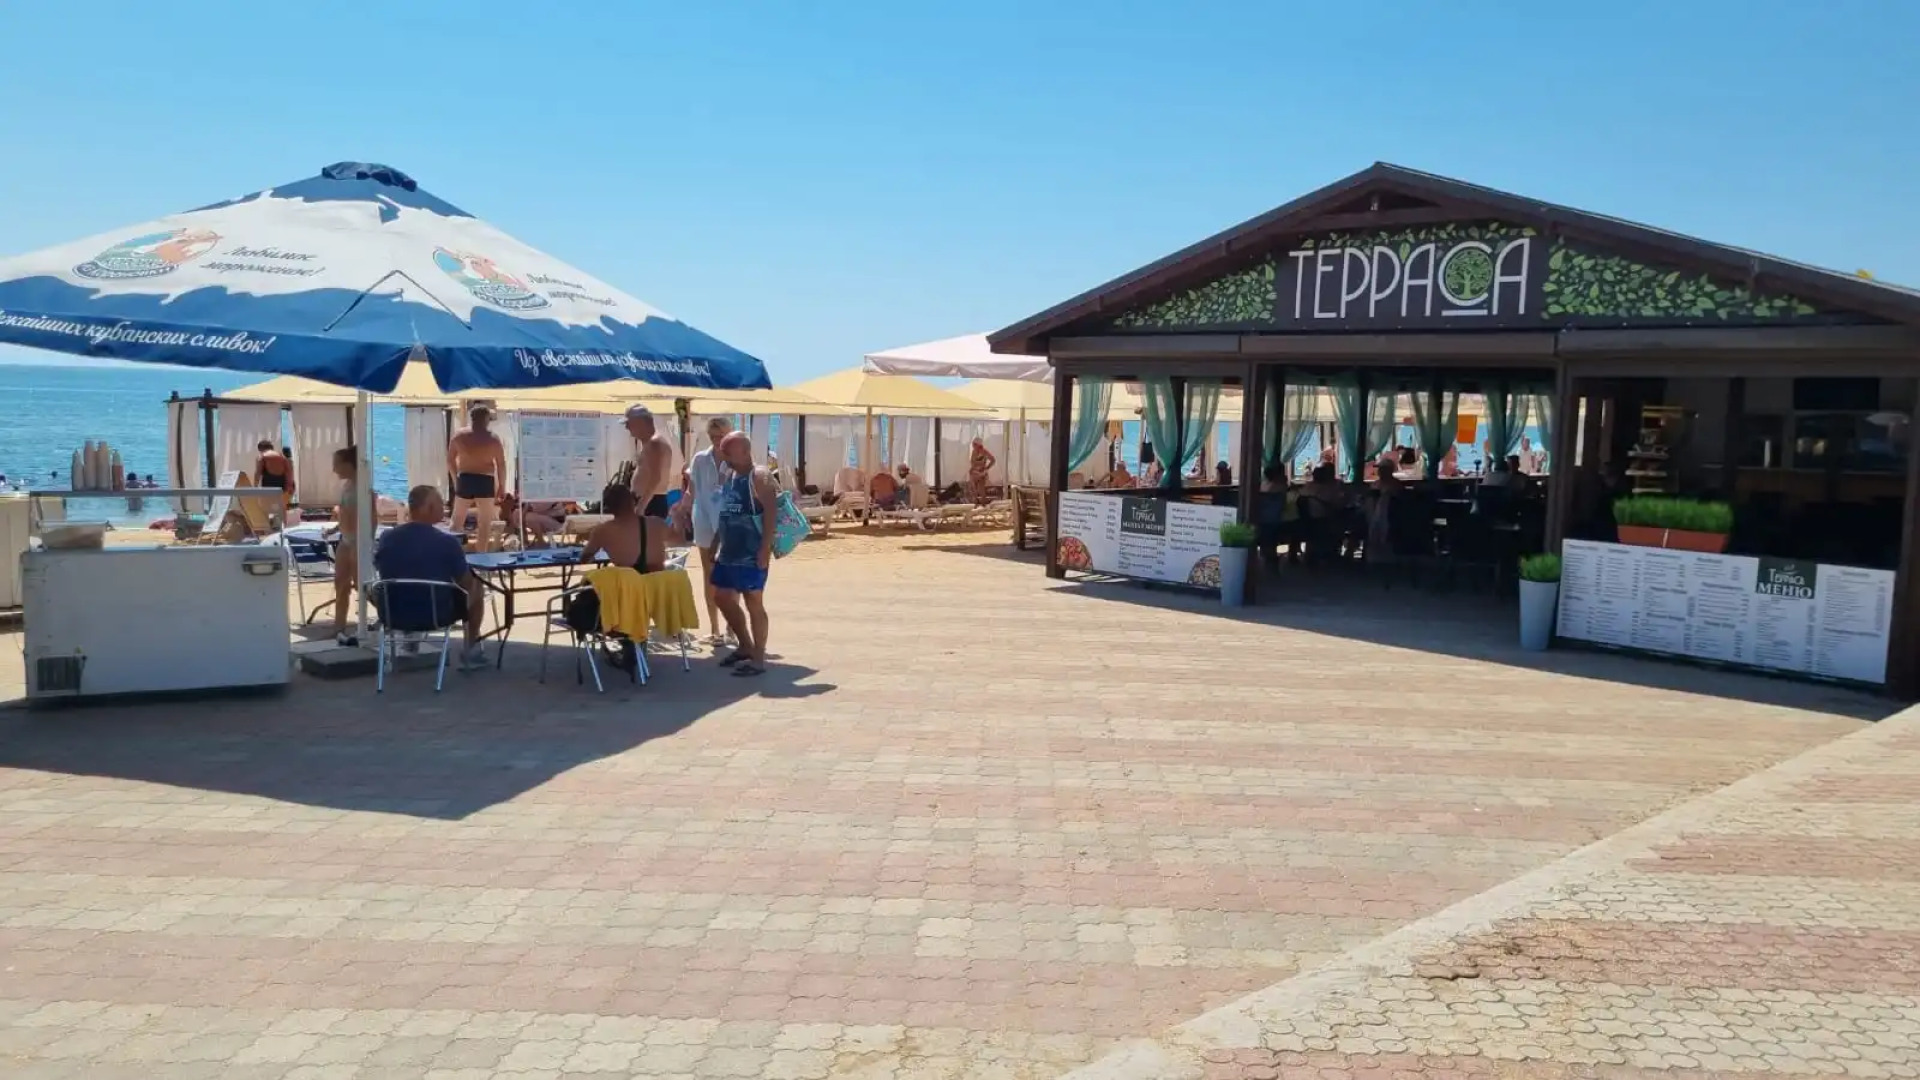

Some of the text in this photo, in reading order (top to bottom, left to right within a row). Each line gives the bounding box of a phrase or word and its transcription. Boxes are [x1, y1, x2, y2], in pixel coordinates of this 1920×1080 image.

[1289, 238, 1530, 318] ТЕРРАСА
[85, 321, 190, 346] кубанских
[190, 331, 277, 354] сливок!
[514, 348, 540, 377] Из
[1757, 581, 1813, 599] МЕНЮ
